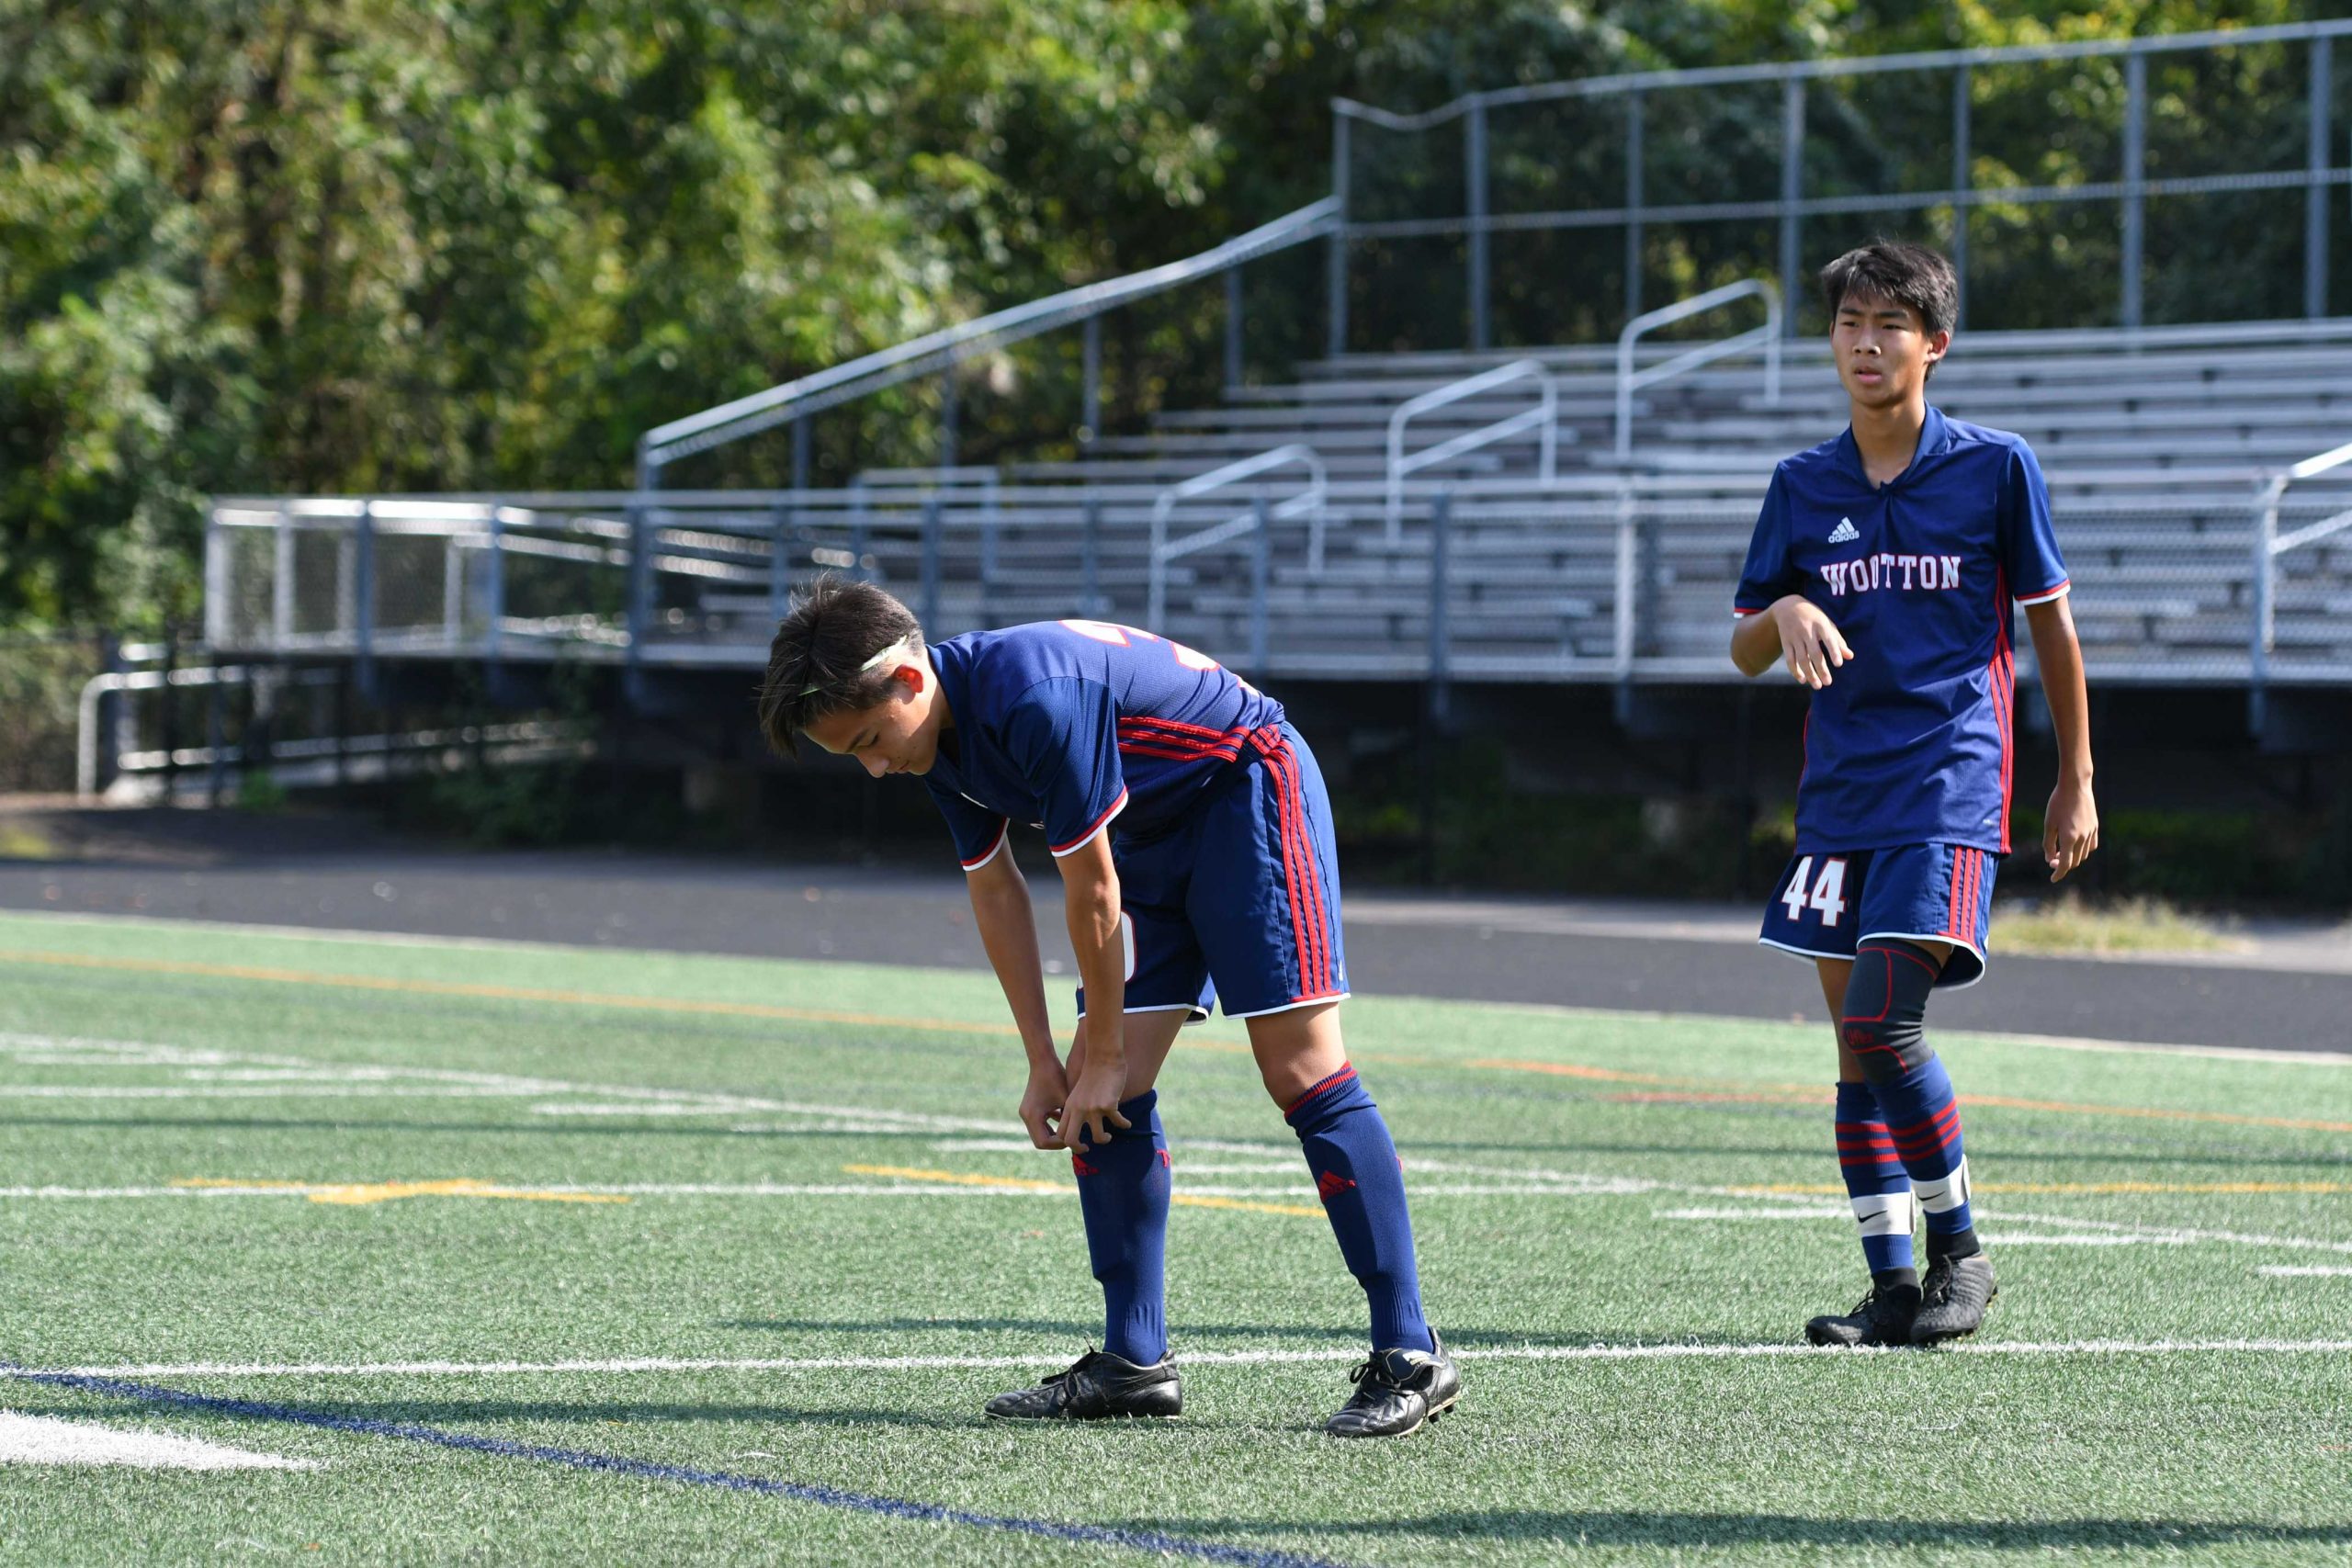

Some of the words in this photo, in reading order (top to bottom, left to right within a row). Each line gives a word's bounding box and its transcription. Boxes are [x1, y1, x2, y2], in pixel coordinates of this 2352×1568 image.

[1827, 530, 1860, 544] adidas
[1820, 553, 1962, 596] WOOTTON
[1781, 855, 1848, 927] 44
